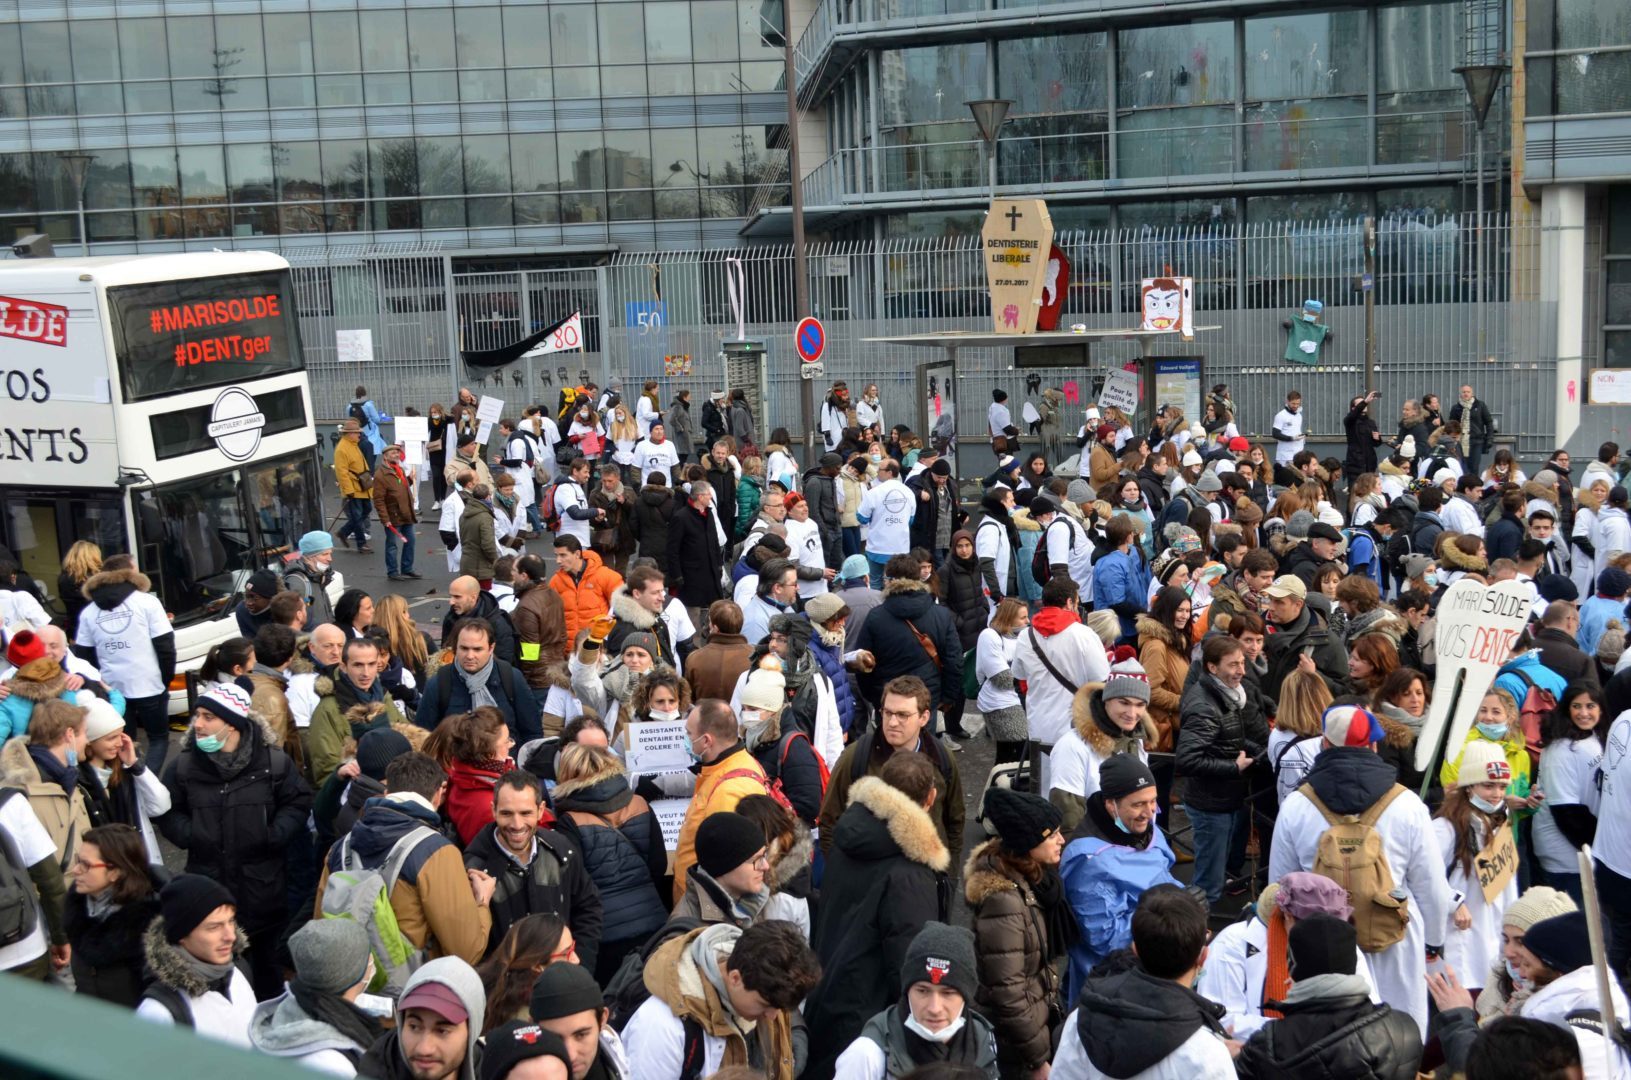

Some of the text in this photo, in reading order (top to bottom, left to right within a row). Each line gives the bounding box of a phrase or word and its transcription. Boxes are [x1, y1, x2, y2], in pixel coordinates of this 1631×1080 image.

[988, 239, 1039, 248] DENTISTERIE
[992, 254, 1031, 263] LIBERALE
[151, 295, 281, 333] #MARISOLDE
[638, 311, 661, 336] 50
[554, 325, 579, 349] 80
[174, 335, 272, 367] #DENTger
[0, 368, 51, 404] OS
[1110, 385, 1125, 396] Pour
[0, 427, 89, 465] NTS
[104, 640, 132, 651] FSDL
[638, 735, 674, 743] DENTAIRE
[640, 726, 683, 735] ASSISTANTE
